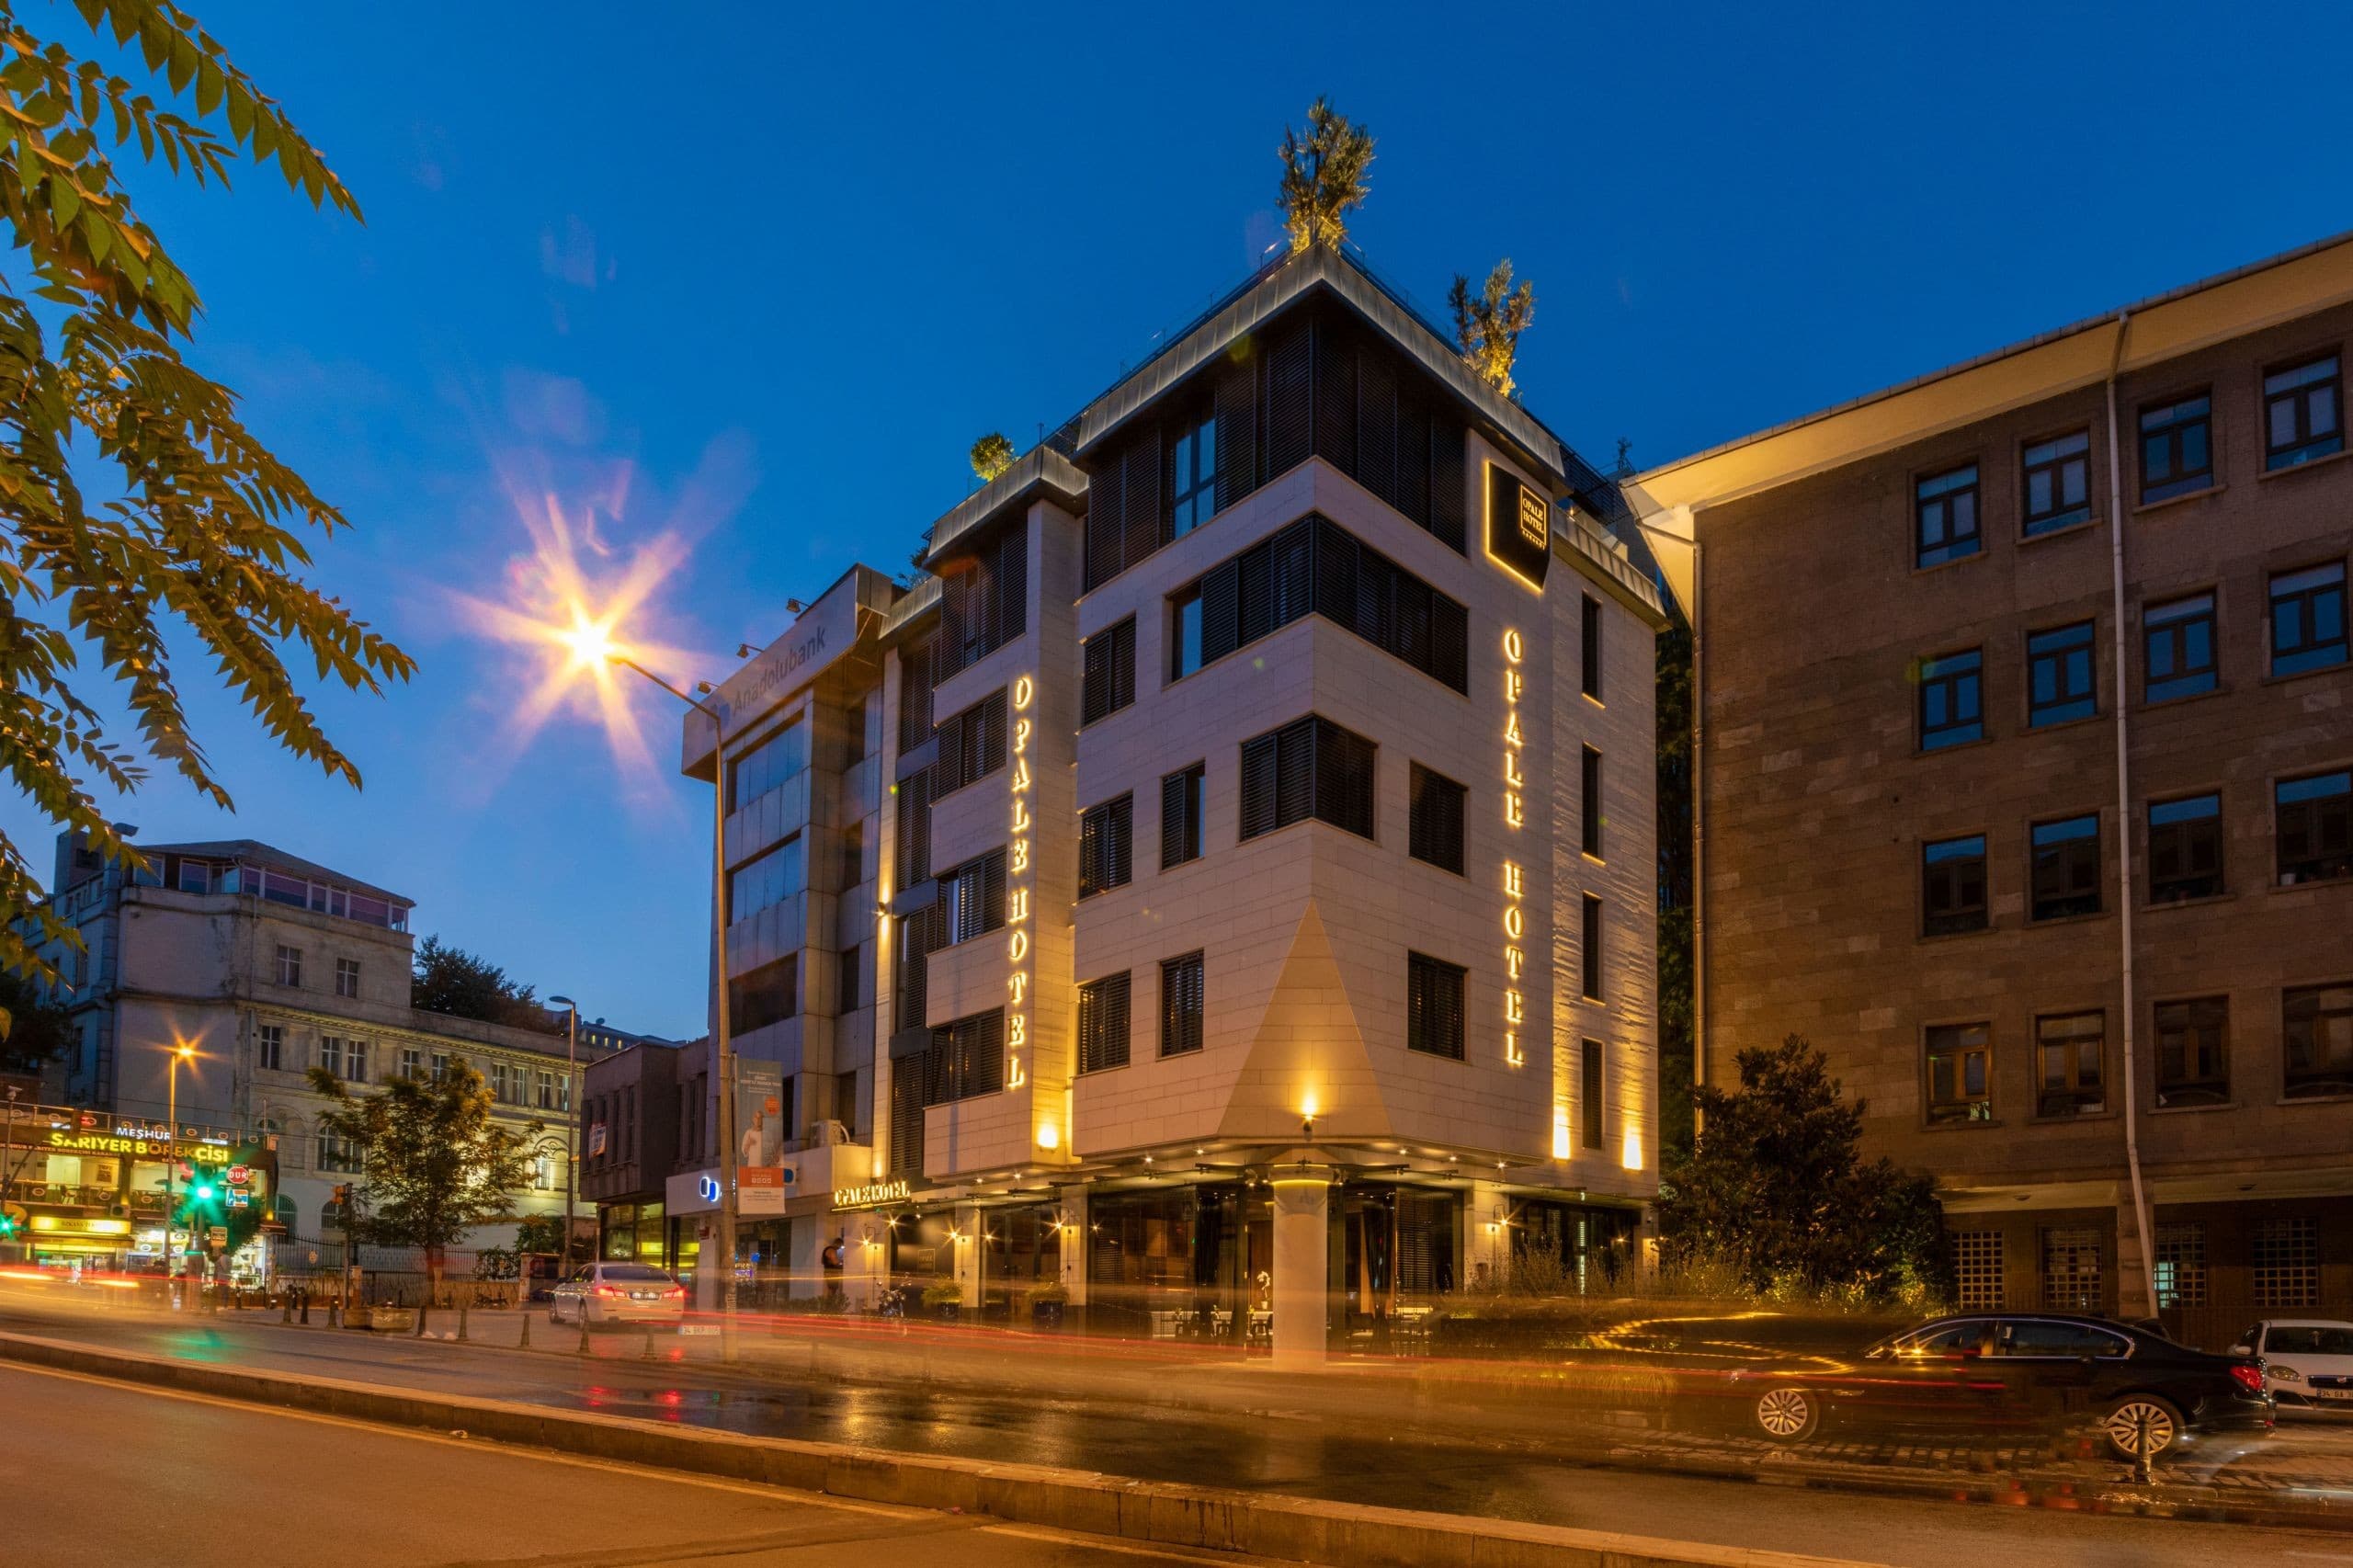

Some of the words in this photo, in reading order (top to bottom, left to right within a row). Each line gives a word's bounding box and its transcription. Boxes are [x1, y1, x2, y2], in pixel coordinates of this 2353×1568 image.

[1522, 497, 1544, 522] OPALE
[1523, 509, 1545, 534] HOTEL
[734, 625, 825, 713] Anadolubank
[1504, 628, 1524, 827] OPALE
[1007, 889, 1029, 1088] HOTEL
[1504, 861, 1525, 1066] HOTEL
[229, 1171, 247, 1179] DUR
